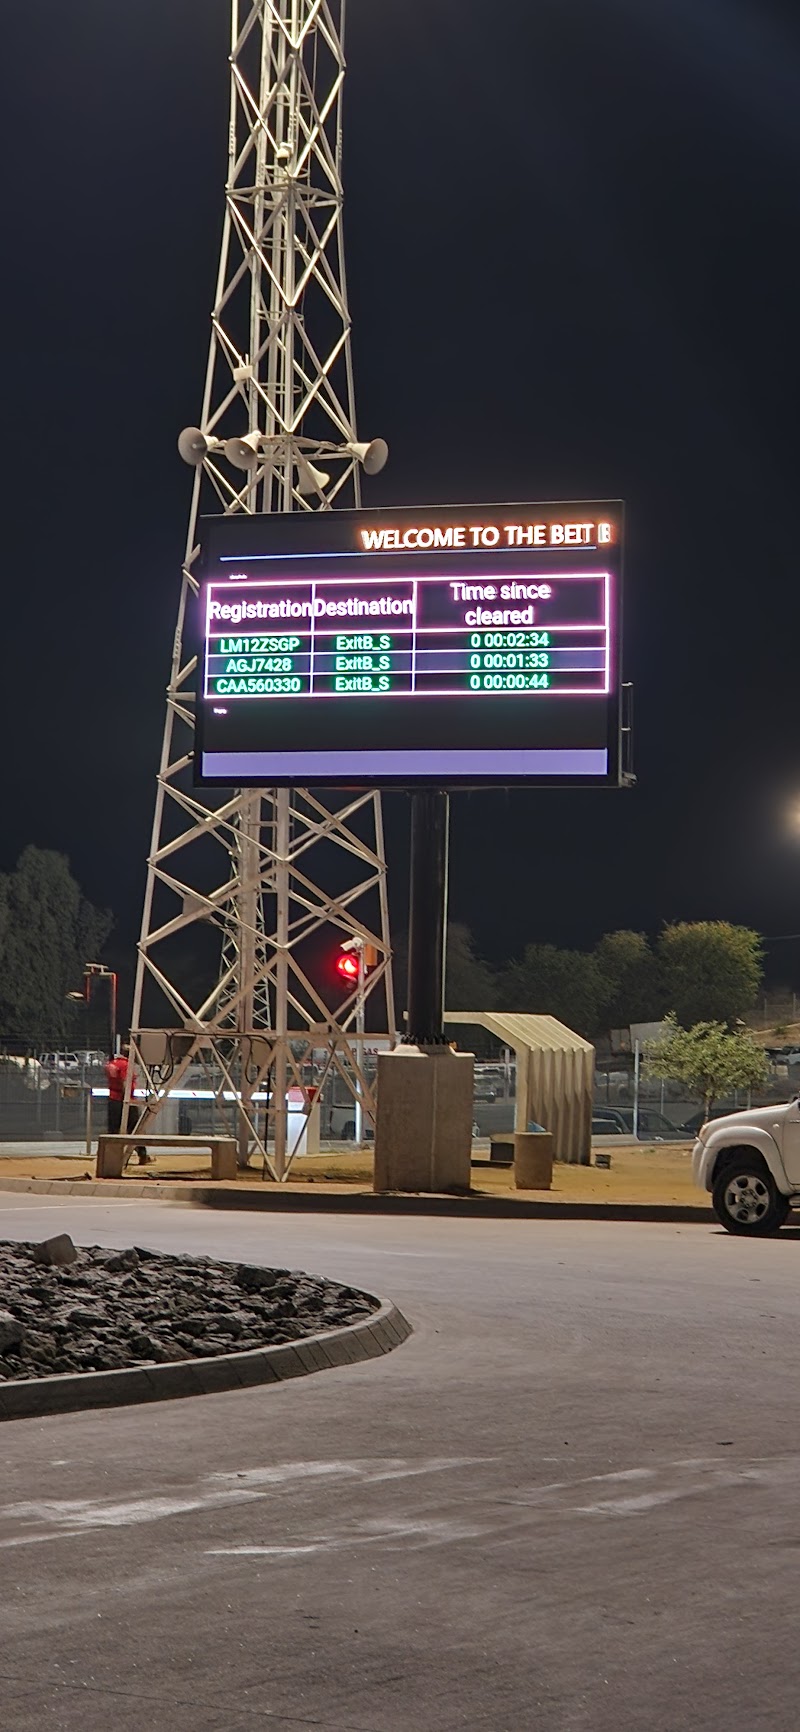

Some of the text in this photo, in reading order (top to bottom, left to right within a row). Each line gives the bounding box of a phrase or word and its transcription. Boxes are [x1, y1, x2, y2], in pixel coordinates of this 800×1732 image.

[361, 526, 466, 549] WELCOME
[469, 525, 500, 546] TO
[504, 524, 547, 546] THE
[450, 581, 552, 601] Time since
[209, 599, 313, 624] Registration
[314, 597, 413, 617] Destination
[465, 605, 534, 625] cleared
[220, 637, 300, 653] LM12ZSGP
[336, 635, 391, 651] ExitB_S
[470, 632, 550, 648] 0 00:02:34
[226, 658, 292, 673] AGJ7428
[335, 656, 391, 671] ExitB_S
[470, 653, 549, 668] 0 00:01:33
[216, 677, 301, 693] CAA560330
[335, 676, 390, 691] ExitB_S
[470, 673, 549, 689] 0 00:00:44
